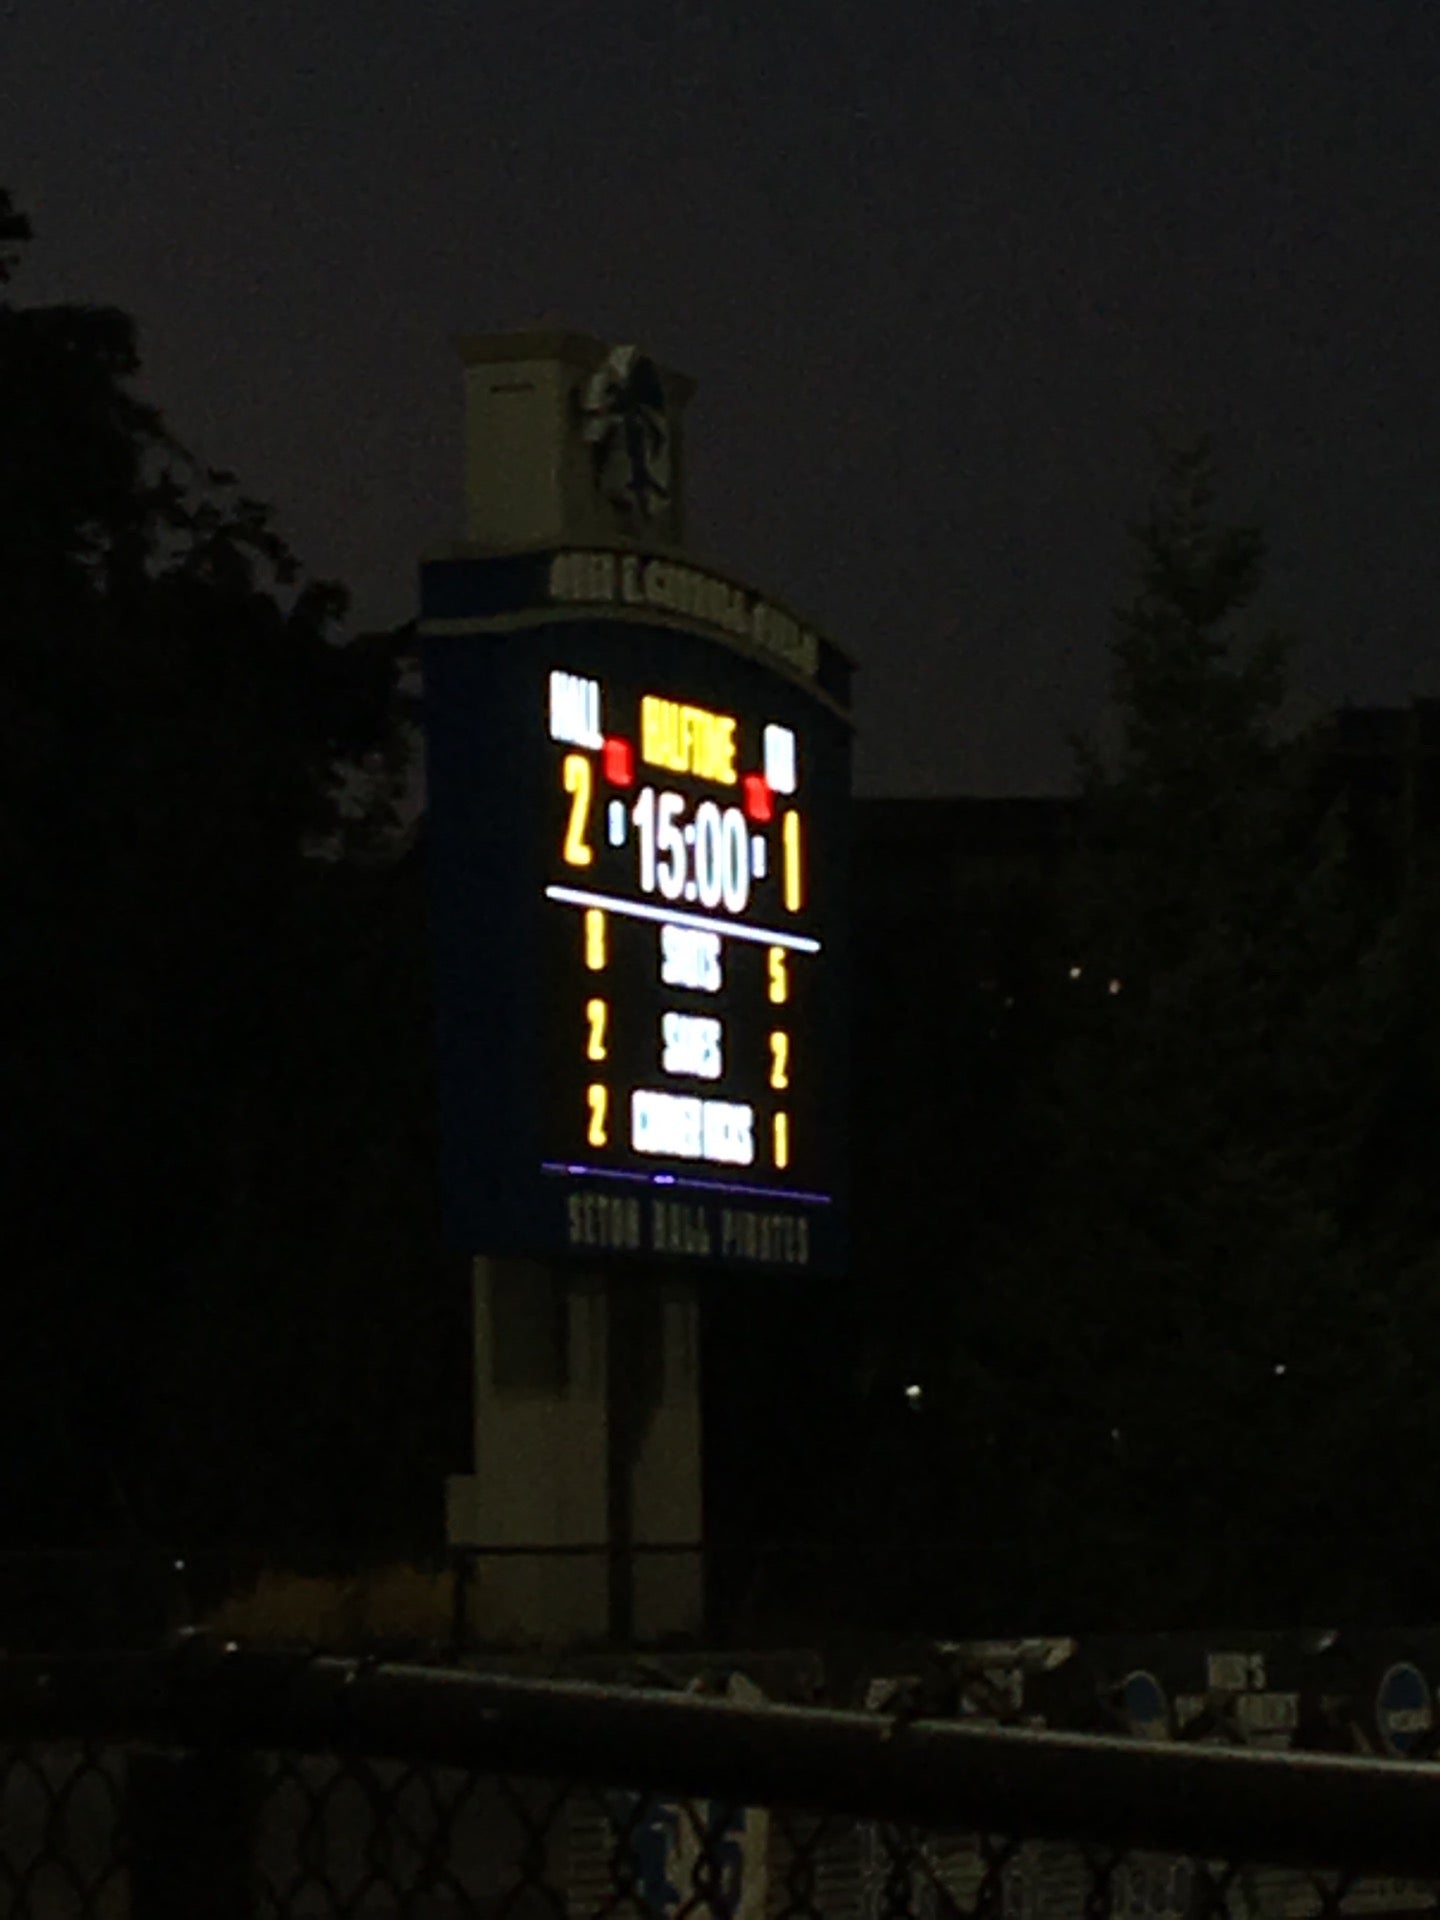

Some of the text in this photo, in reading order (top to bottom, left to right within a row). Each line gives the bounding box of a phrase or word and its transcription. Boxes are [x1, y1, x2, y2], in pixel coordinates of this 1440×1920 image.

[565, 755, 590, 864] 2
[632, 788, 748, 912] 15:00
[785, 811, 799, 911] 1
[770, 947, 785, 1002] 5
[588, 1000, 605, 1059] 2
[771, 1032, 787, 1088] 2
[589, 1085, 606, 1145] 2
[775, 1113, 786, 1167] 1
